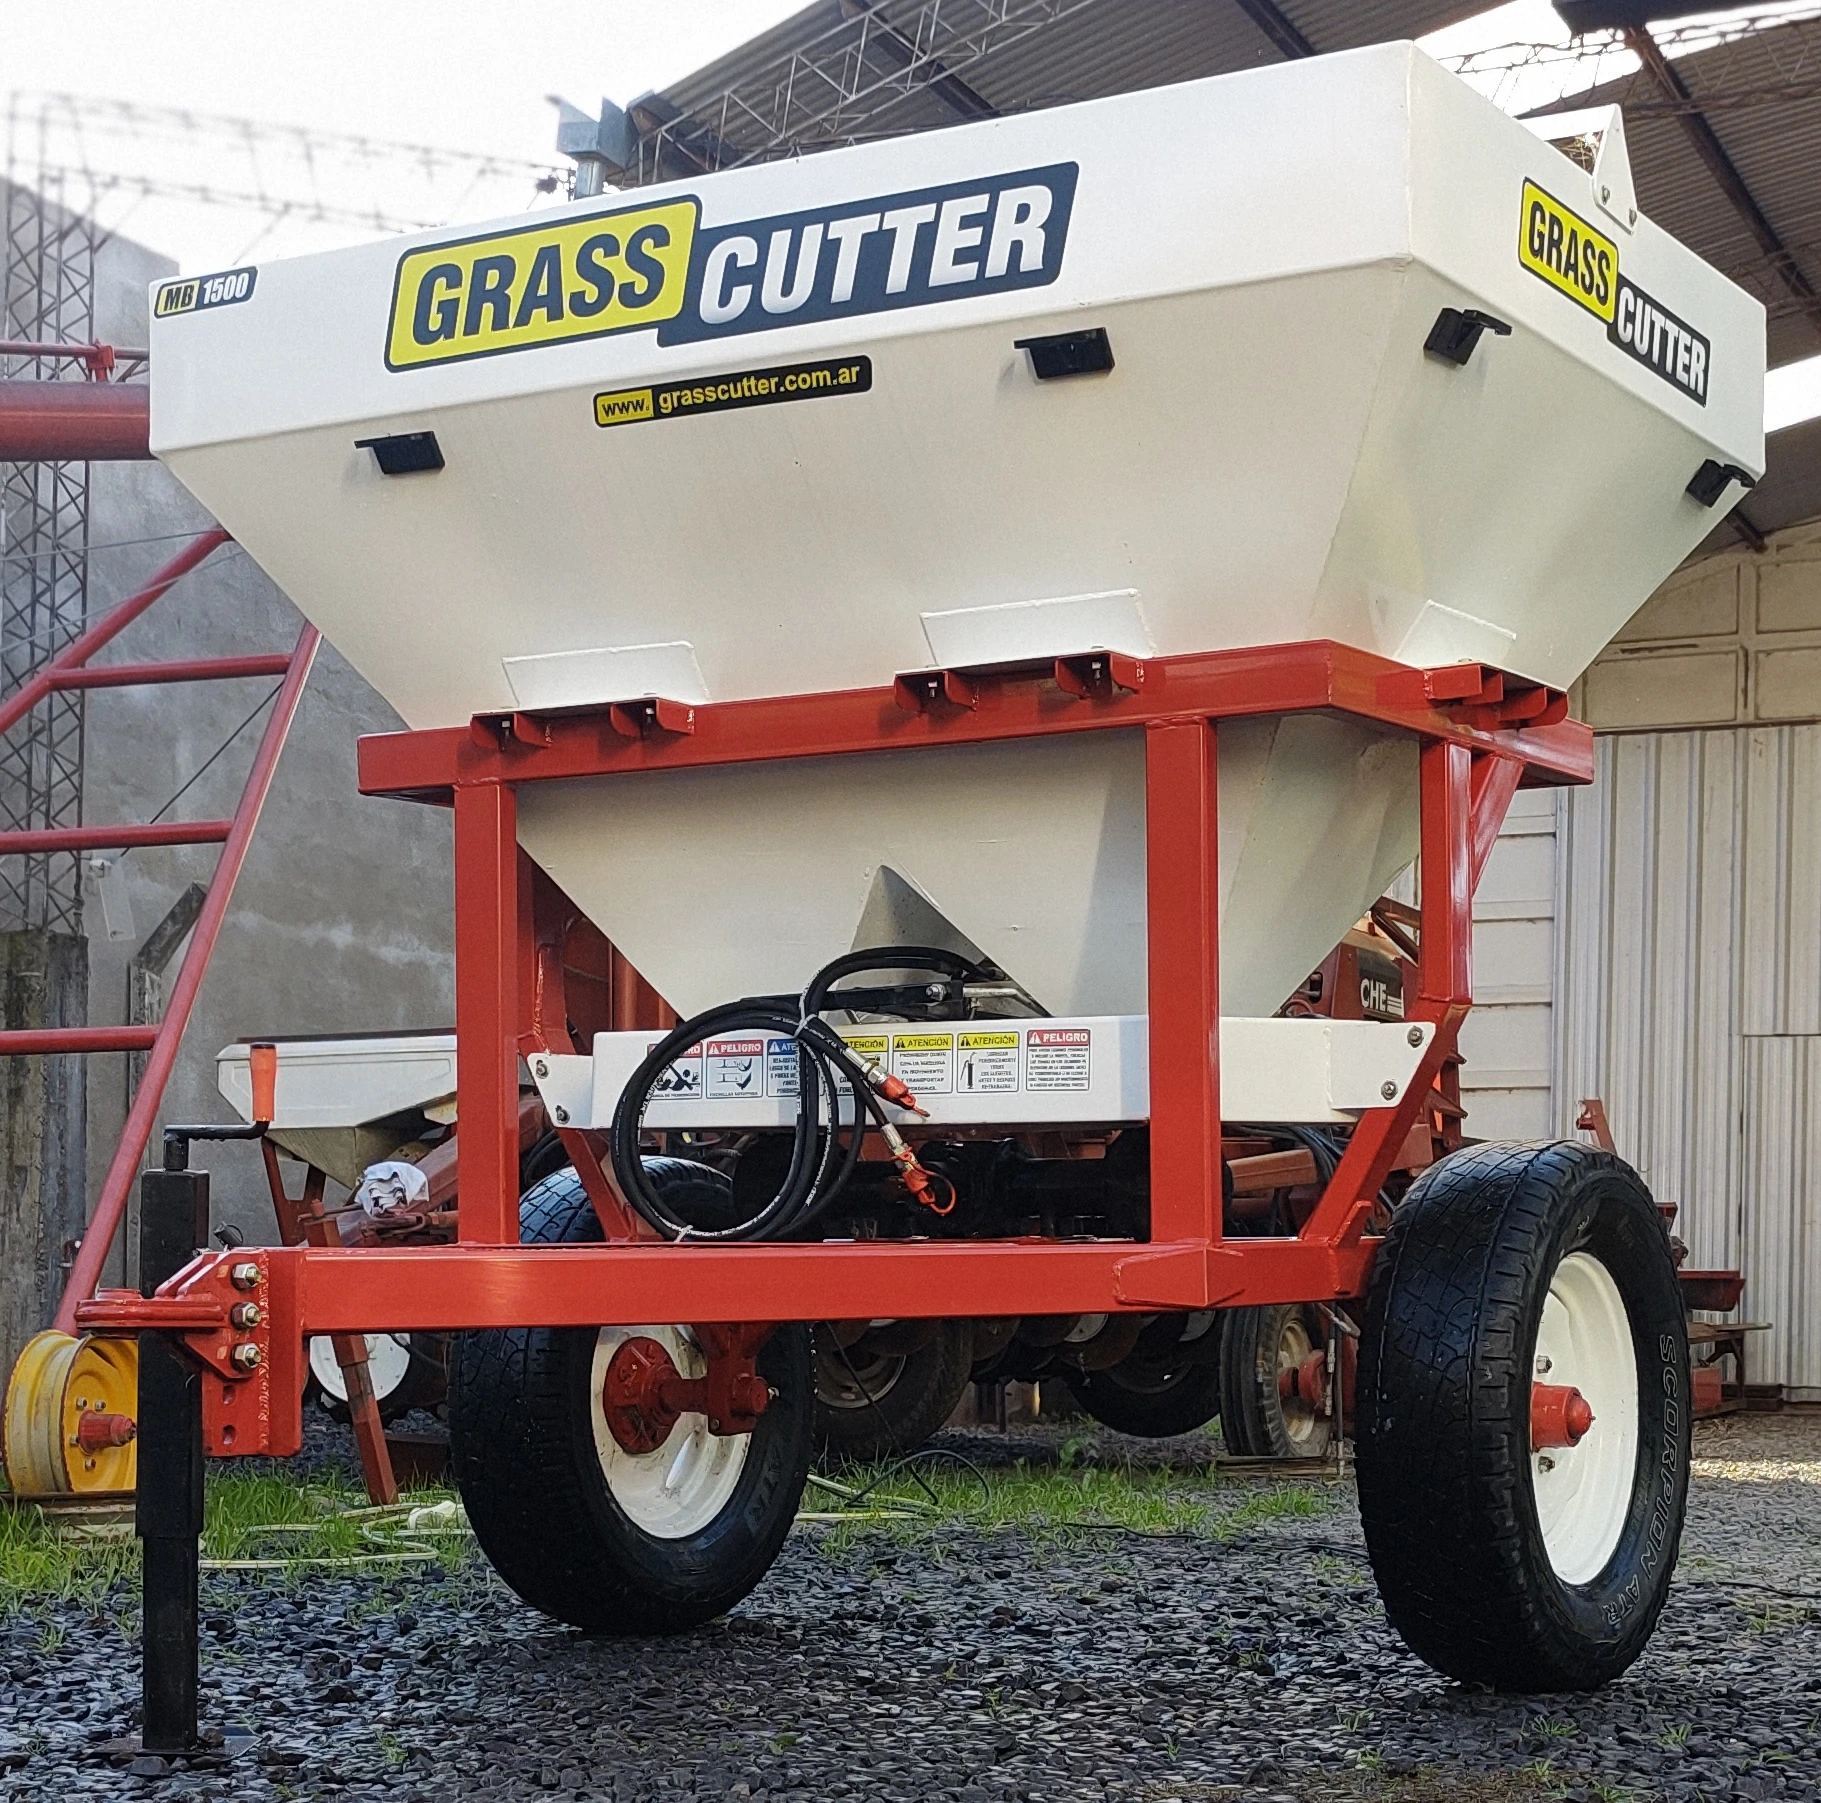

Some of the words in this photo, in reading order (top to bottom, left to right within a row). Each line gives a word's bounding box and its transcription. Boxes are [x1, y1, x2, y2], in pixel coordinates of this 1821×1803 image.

[412, 223, 671, 346] GRASS
[700, 184, 1053, 326] CUTTER
[163, 284, 195, 312] MB
[203, 272, 250, 305] 1500
[1528, 200, 1611, 307] GRASS
[1617, 286, 1707, 397] CUTTER
[601, 396, 650, 418] www.
[658, 364, 861, 414] grasscutter.com.ar
[720, 1043, 761, 1054] PELIGRO
[845, 1040, 884, 1049] TENCIÓN
[1042, 1032, 1089, 1043] PELIGRO
[1640, 1334, 1679, 1580] SCORPION
[1601, 1573, 1640, 1626] ATR
